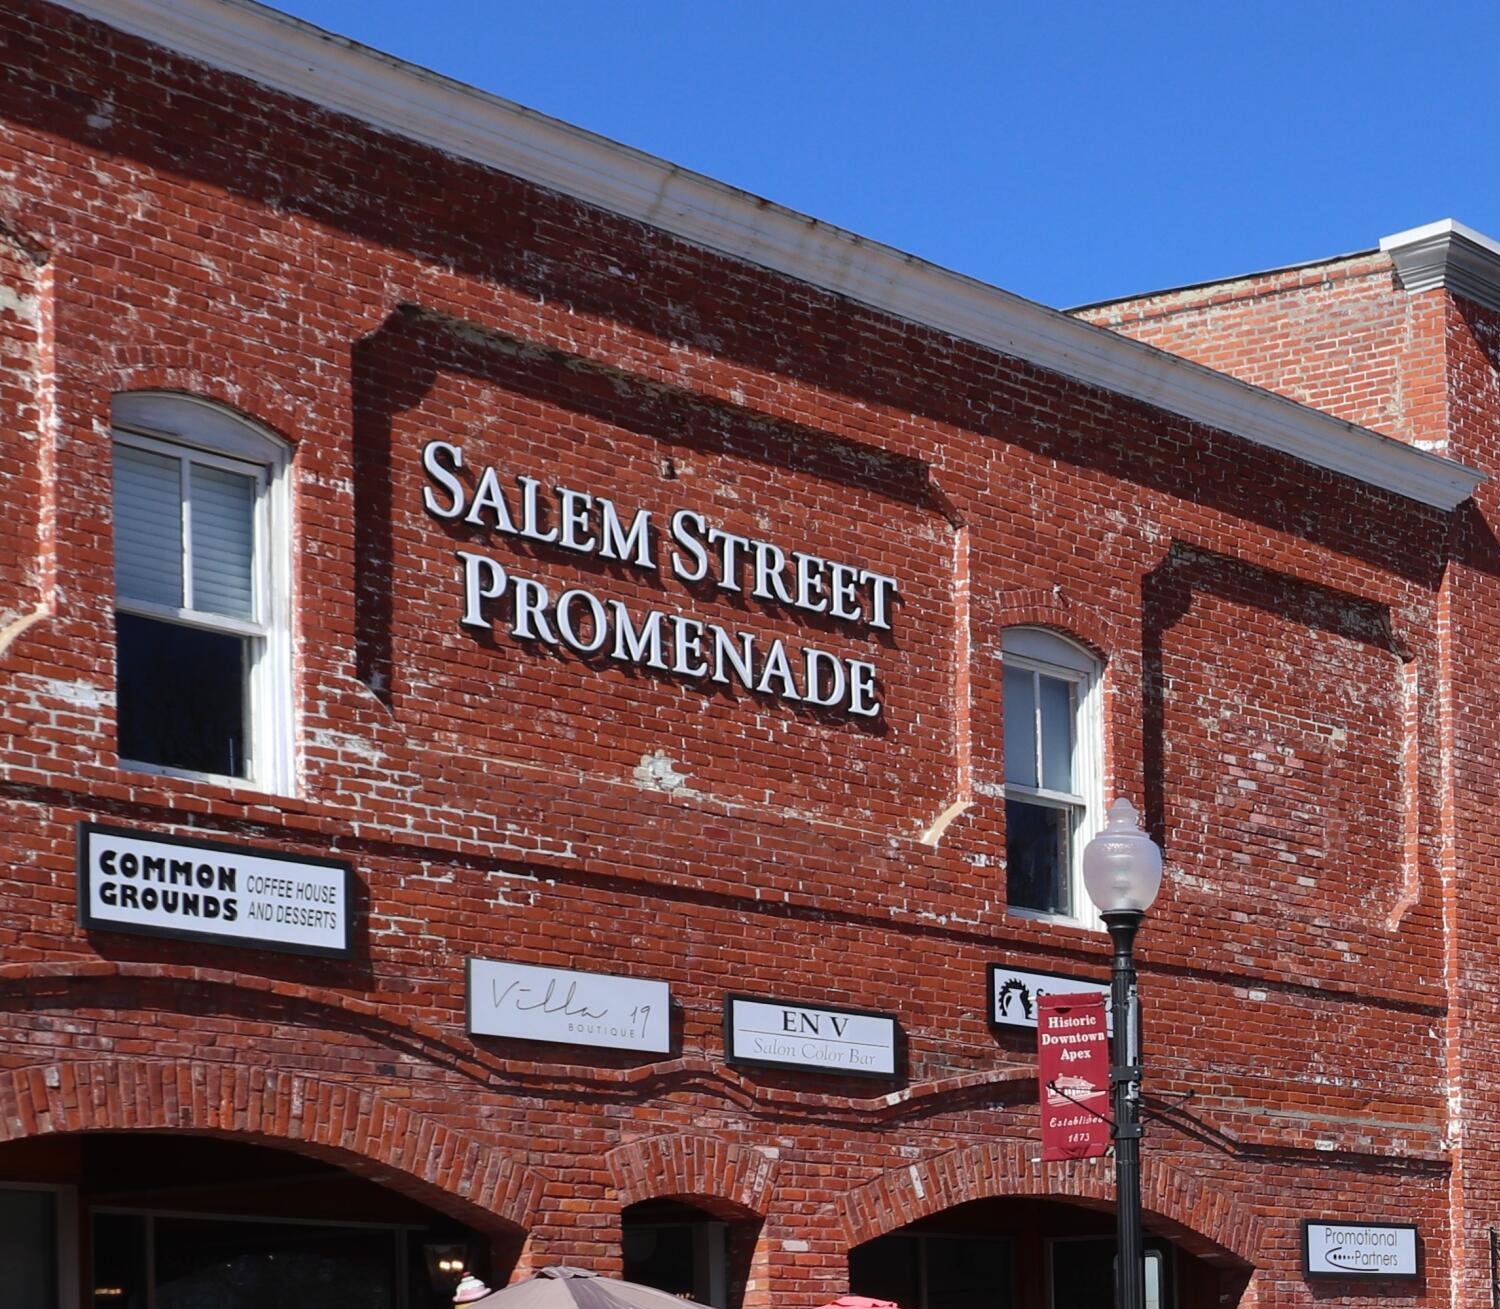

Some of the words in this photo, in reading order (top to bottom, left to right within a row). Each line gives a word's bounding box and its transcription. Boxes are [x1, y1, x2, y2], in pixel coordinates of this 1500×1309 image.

[423, 440, 657, 569] SALEM
[672, 508, 898, 631] STREET
[456, 550, 883, 718] PROMENADE
[99, 849, 237, 893] COMMON
[246, 874, 293, 898] COFFEE
[295, 881, 337, 905] HOUSE
[99, 881, 239, 923] GROUNDS
[247, 901, 274, 922] AND
[275, 904, 337, 930] DESSERTS
[568, 1022, 636, 1039] BOUTIQUE
[630, 1005, 651, 1039] 19
[1048, 1014, 1097, 1029] Historic
[1041, 1031, 1105, 1046] Downtown
[753, 1037, 796, 1057] Salon
[801, 1042, 844, 1062] Color
[848, 1047, 876, 1066] Bar
[1060, 1049, 1092, 1062] Apex
[1049, 1113, 1104, 1129] Established
[1067, 1132, 1090, 1143] 1873
[1325, 1227, 1398, 1247] Promotional
[1354, 1250, 1398, 1266] Partners
